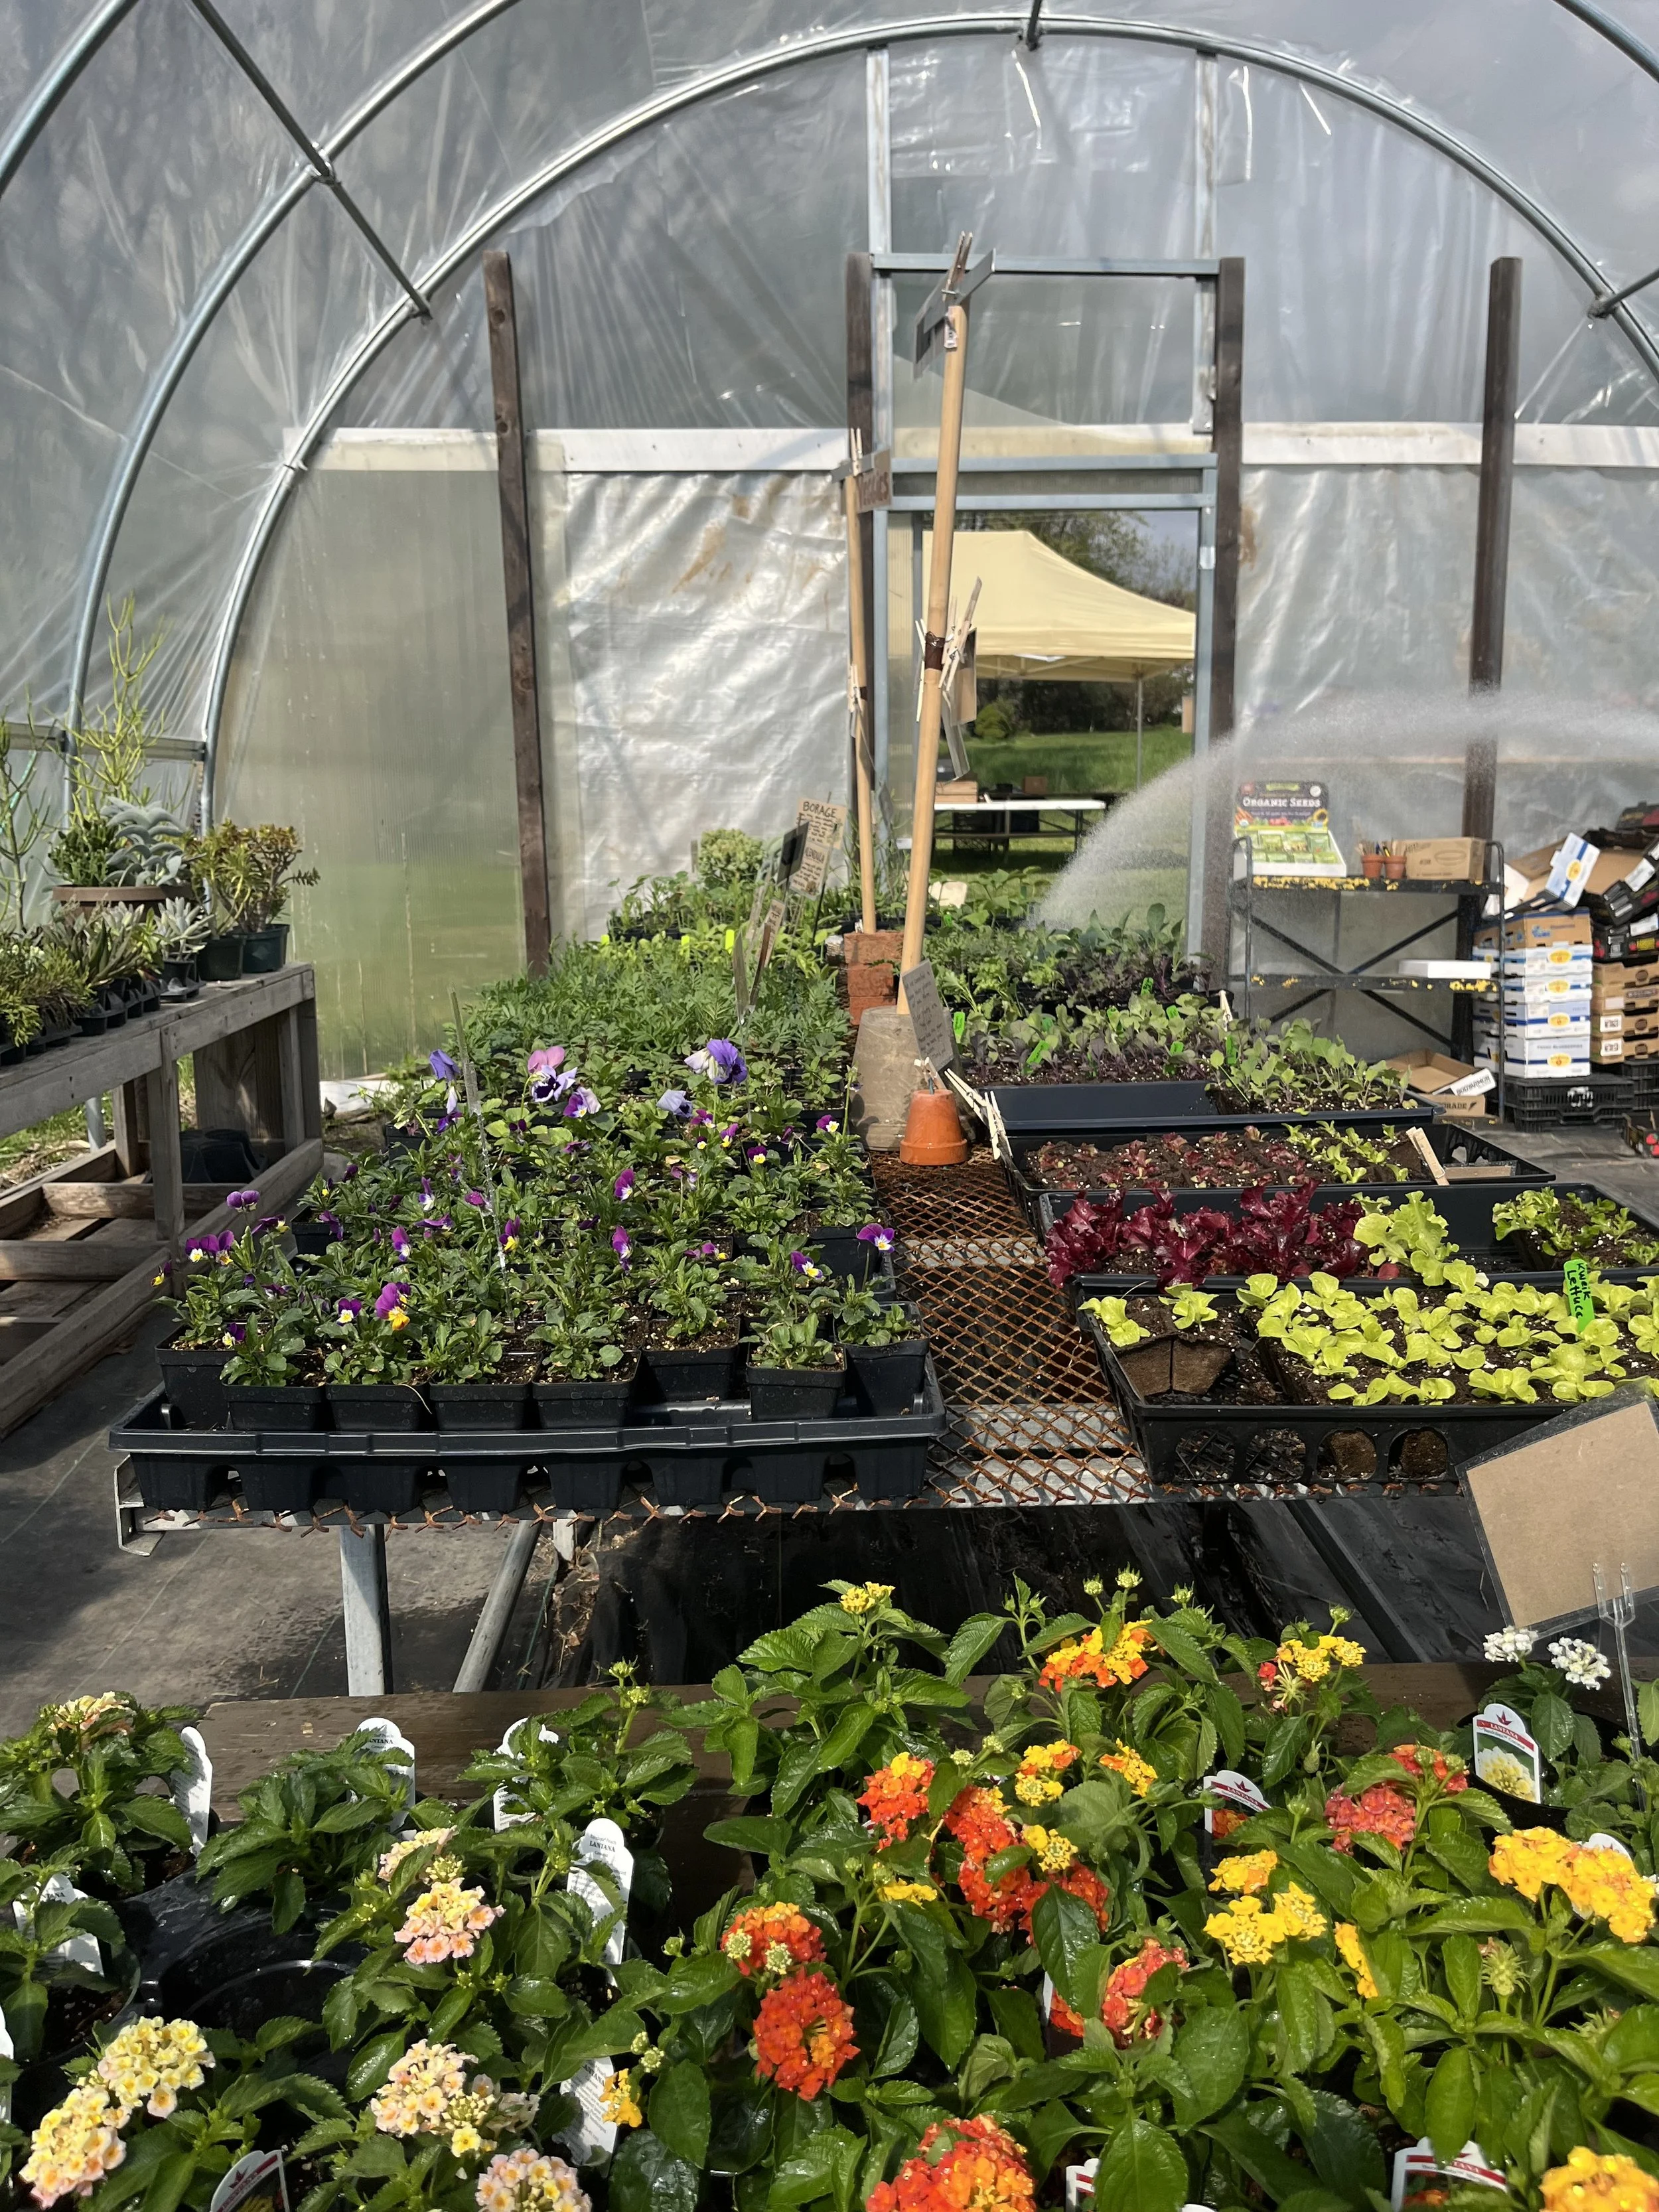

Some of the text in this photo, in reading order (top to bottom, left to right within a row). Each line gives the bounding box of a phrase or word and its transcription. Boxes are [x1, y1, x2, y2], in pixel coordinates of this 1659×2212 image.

[802, 800, 837, 818] BORAGE
[1490, 1724, 1519, 1739] LANTANA
[1227, 1787, 1259, 1806] LANTANA
[589, 1840, 616, 1852] LANTANA
